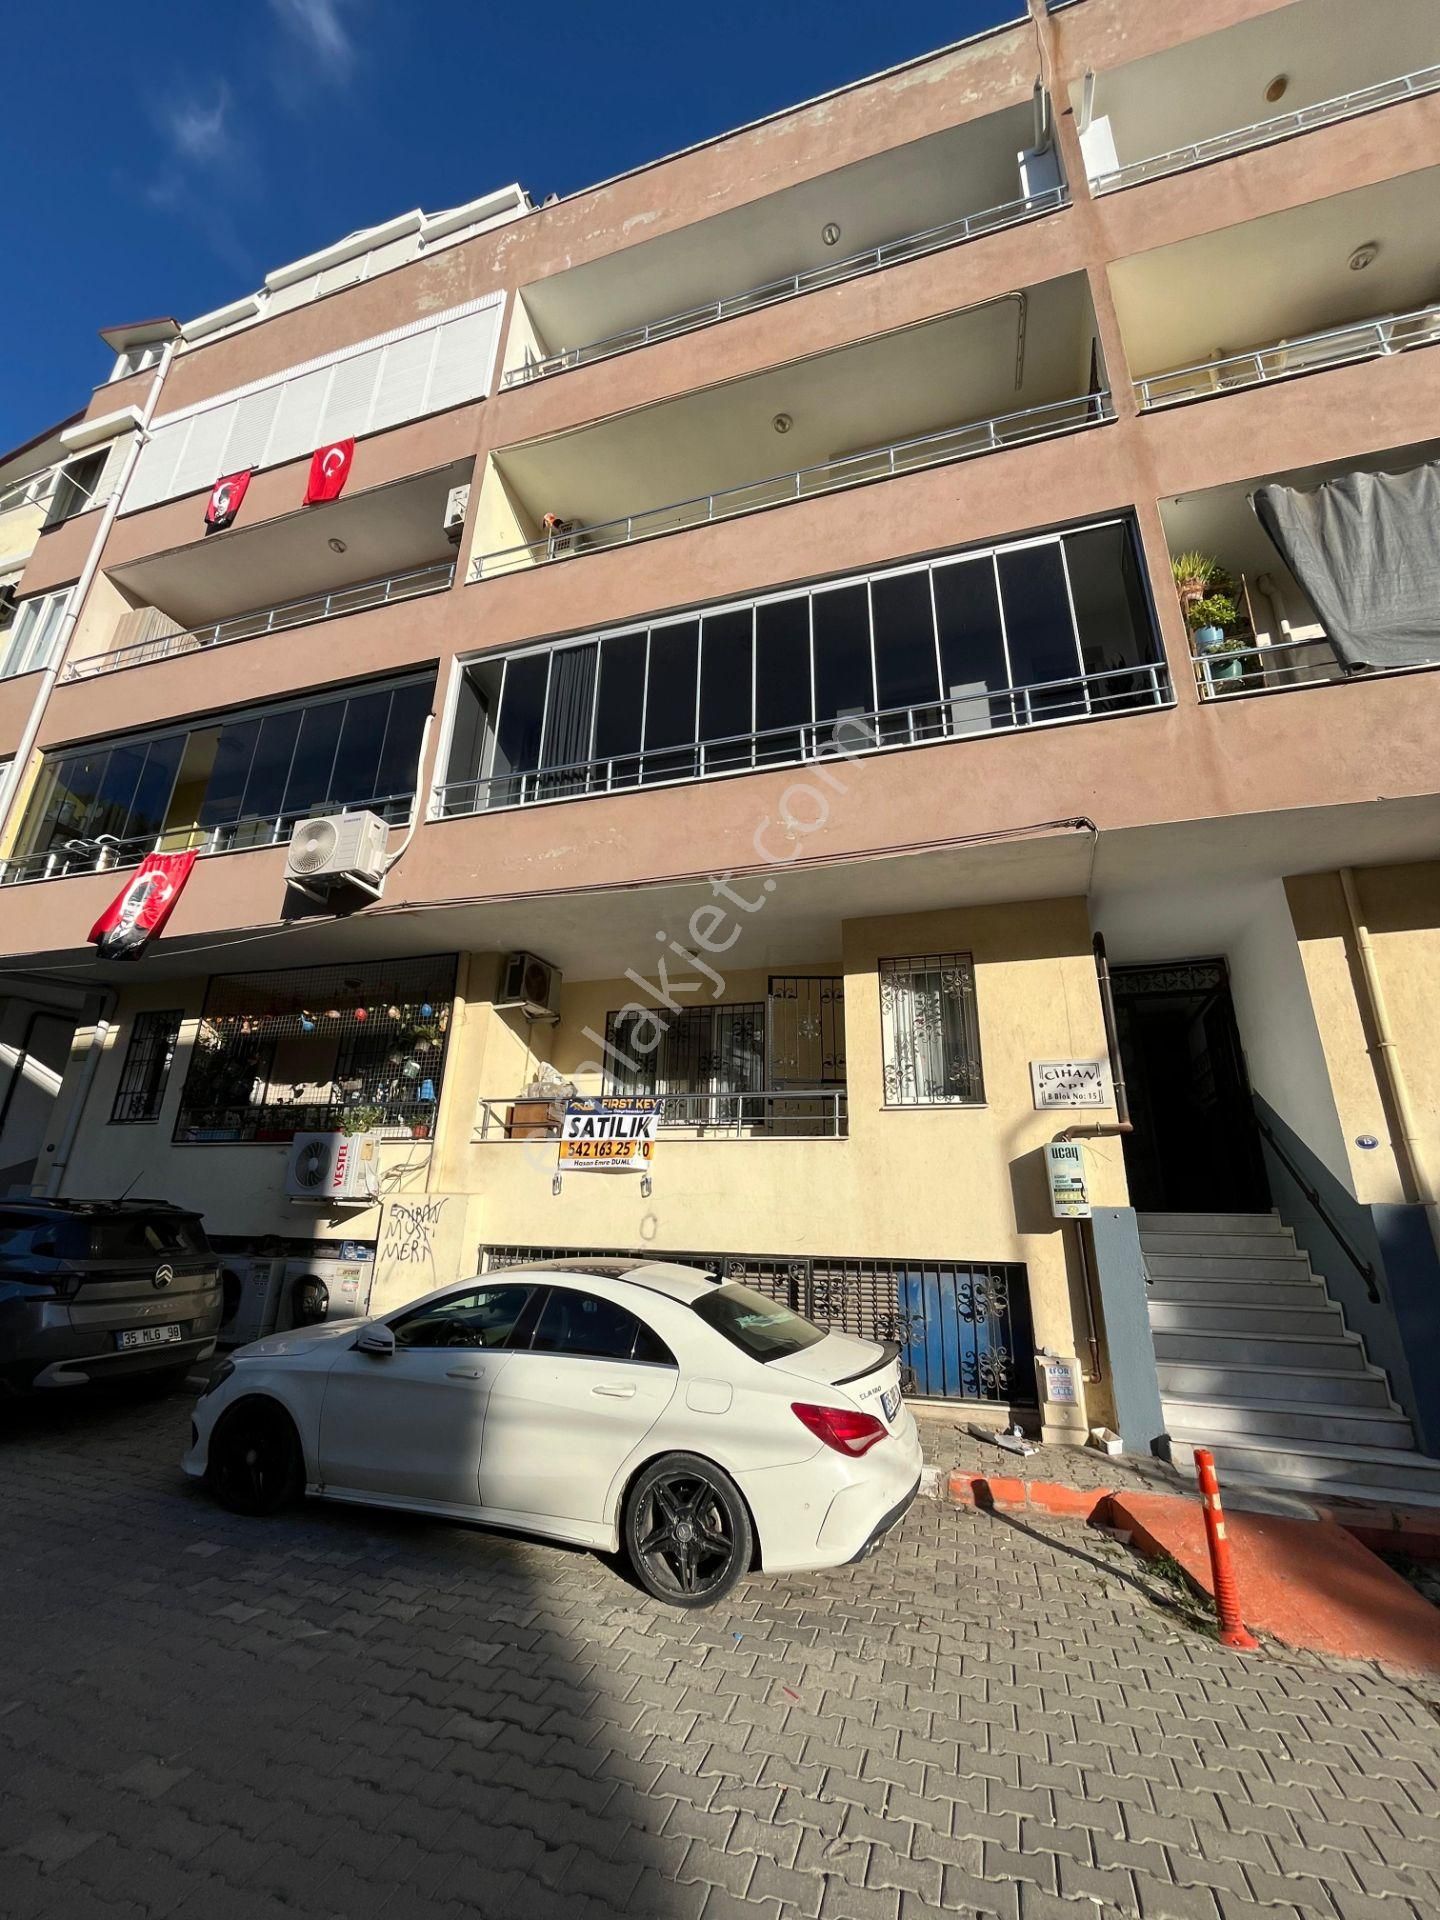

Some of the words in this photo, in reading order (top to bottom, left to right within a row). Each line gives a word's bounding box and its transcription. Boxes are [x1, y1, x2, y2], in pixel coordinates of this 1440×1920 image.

[1056, 1082, 1085, 1090] Apt
[1054, 1092, 1071, 1100] Blok
[1072, 1092, 1087, 1100] No:
[1088, 1092, 1097, 1100] 15
[601, 1098, 634, 1110] FIRST
[635, 1098, 656, 1109] KEY
[568, 1116, 653, 1138] SATILIK
[568, 1141, 591, 1157] 542
[594, 1141, 613, 1157] 163
[615, 1141, 631, 1156] 25
[333, 1143, 349, 1188] VESTEL
[124, 1332, 137, 1345] 35
[142, 1328, 160, 1343] MLG
[860, 1390, 873, 1400] CLA
